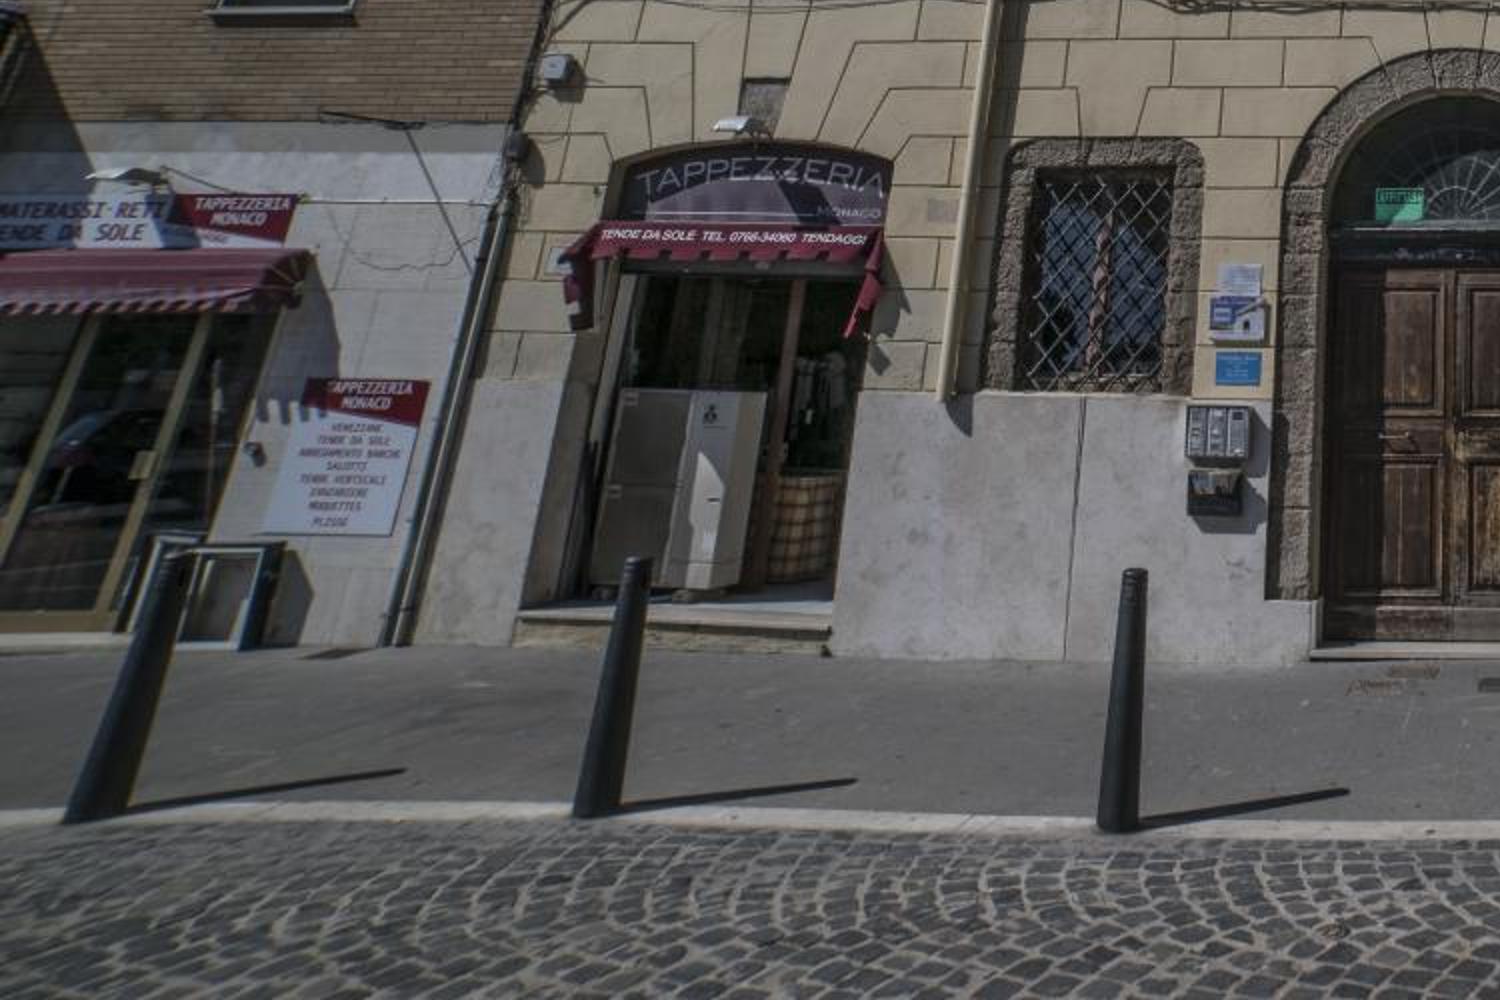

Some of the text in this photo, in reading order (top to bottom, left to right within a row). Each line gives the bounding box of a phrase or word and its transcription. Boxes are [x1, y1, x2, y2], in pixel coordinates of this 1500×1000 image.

[635, 157, 884, 199] TAPPEZZERIA
[194, 197, 291, 211] TAPPEZZERIA
[209, 211, 268, 226] MONACO
[95, 222, 148, 241] SOLE
[601, 228, 642, 241] TENDE
[641, 229, 661, 241] DA
[661, 229, 698, 241] SOLE
[340, 395, 392, 409] MONACO
